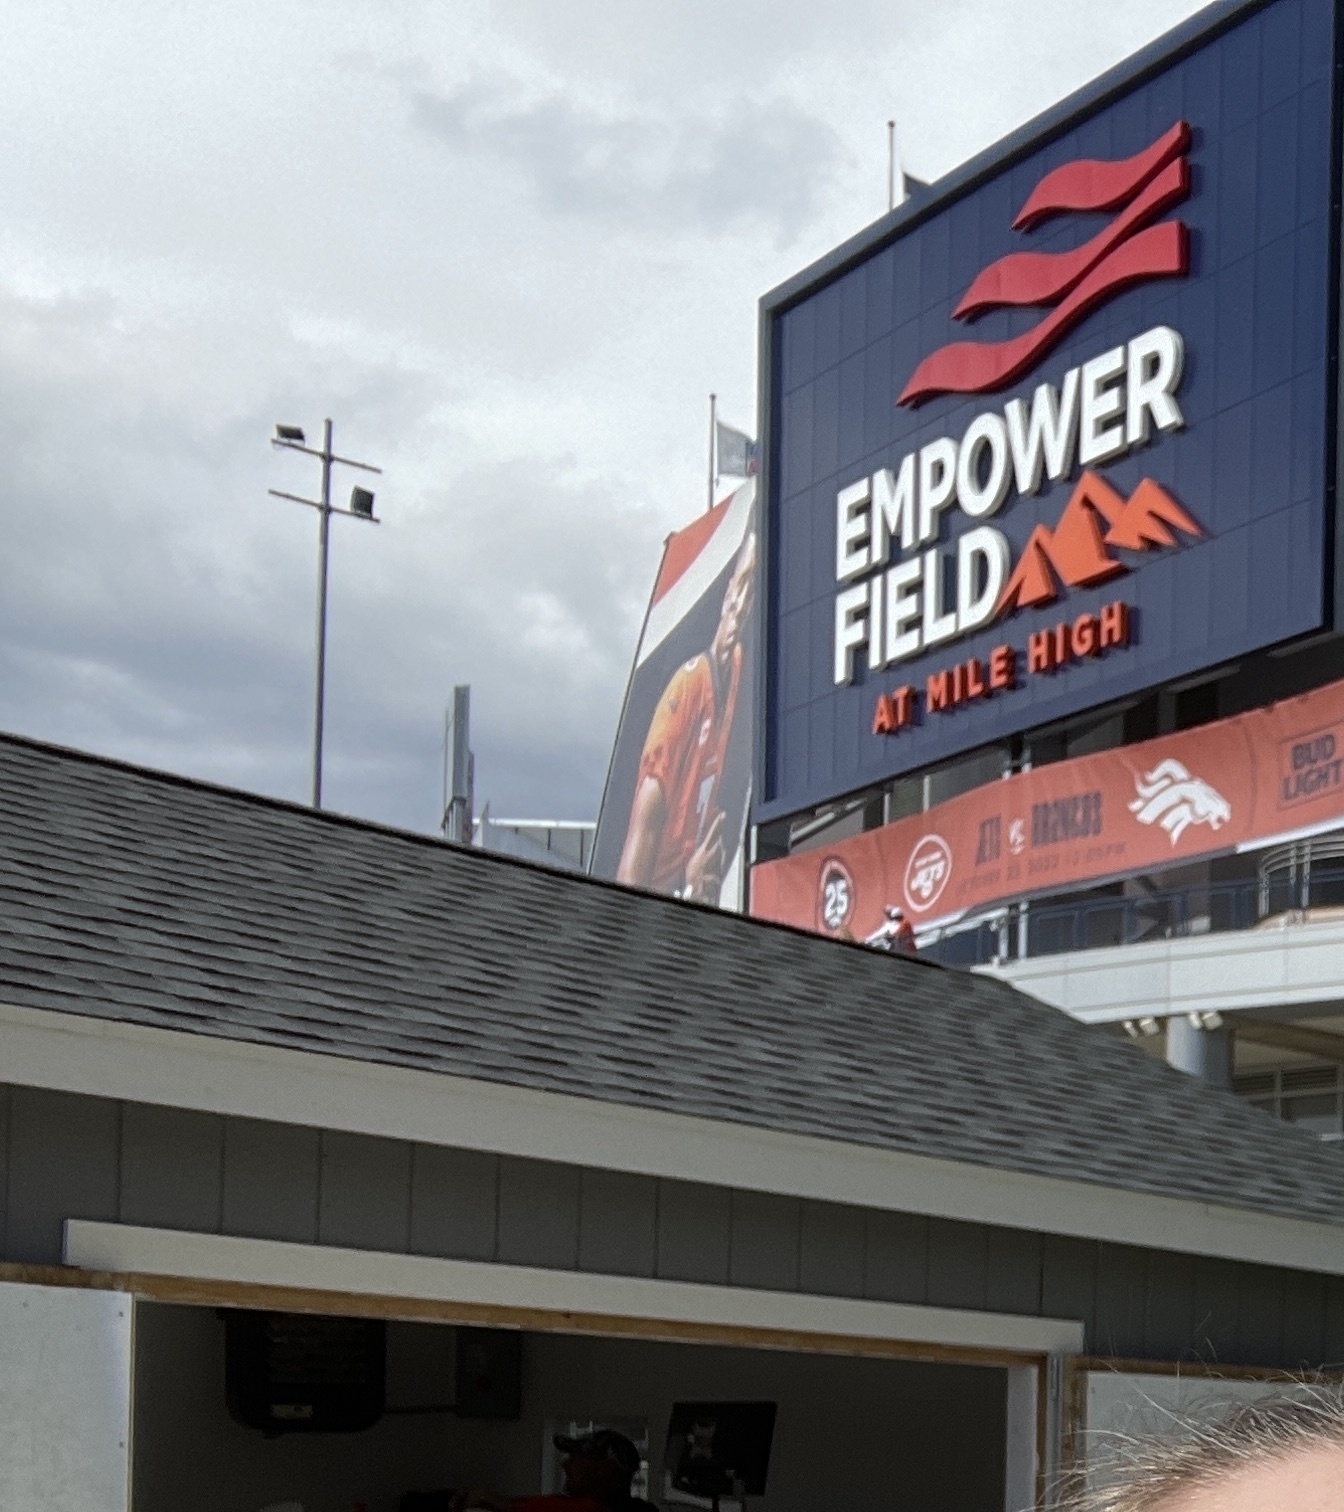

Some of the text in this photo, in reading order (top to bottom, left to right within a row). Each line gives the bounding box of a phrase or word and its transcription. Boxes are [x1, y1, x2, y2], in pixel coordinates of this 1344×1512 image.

[836, 326, 1184, 582] EMPOWER
[833, 526, 1010, 687] FIELD
[872, 601, 1130, 735] AT MILE HIGH
